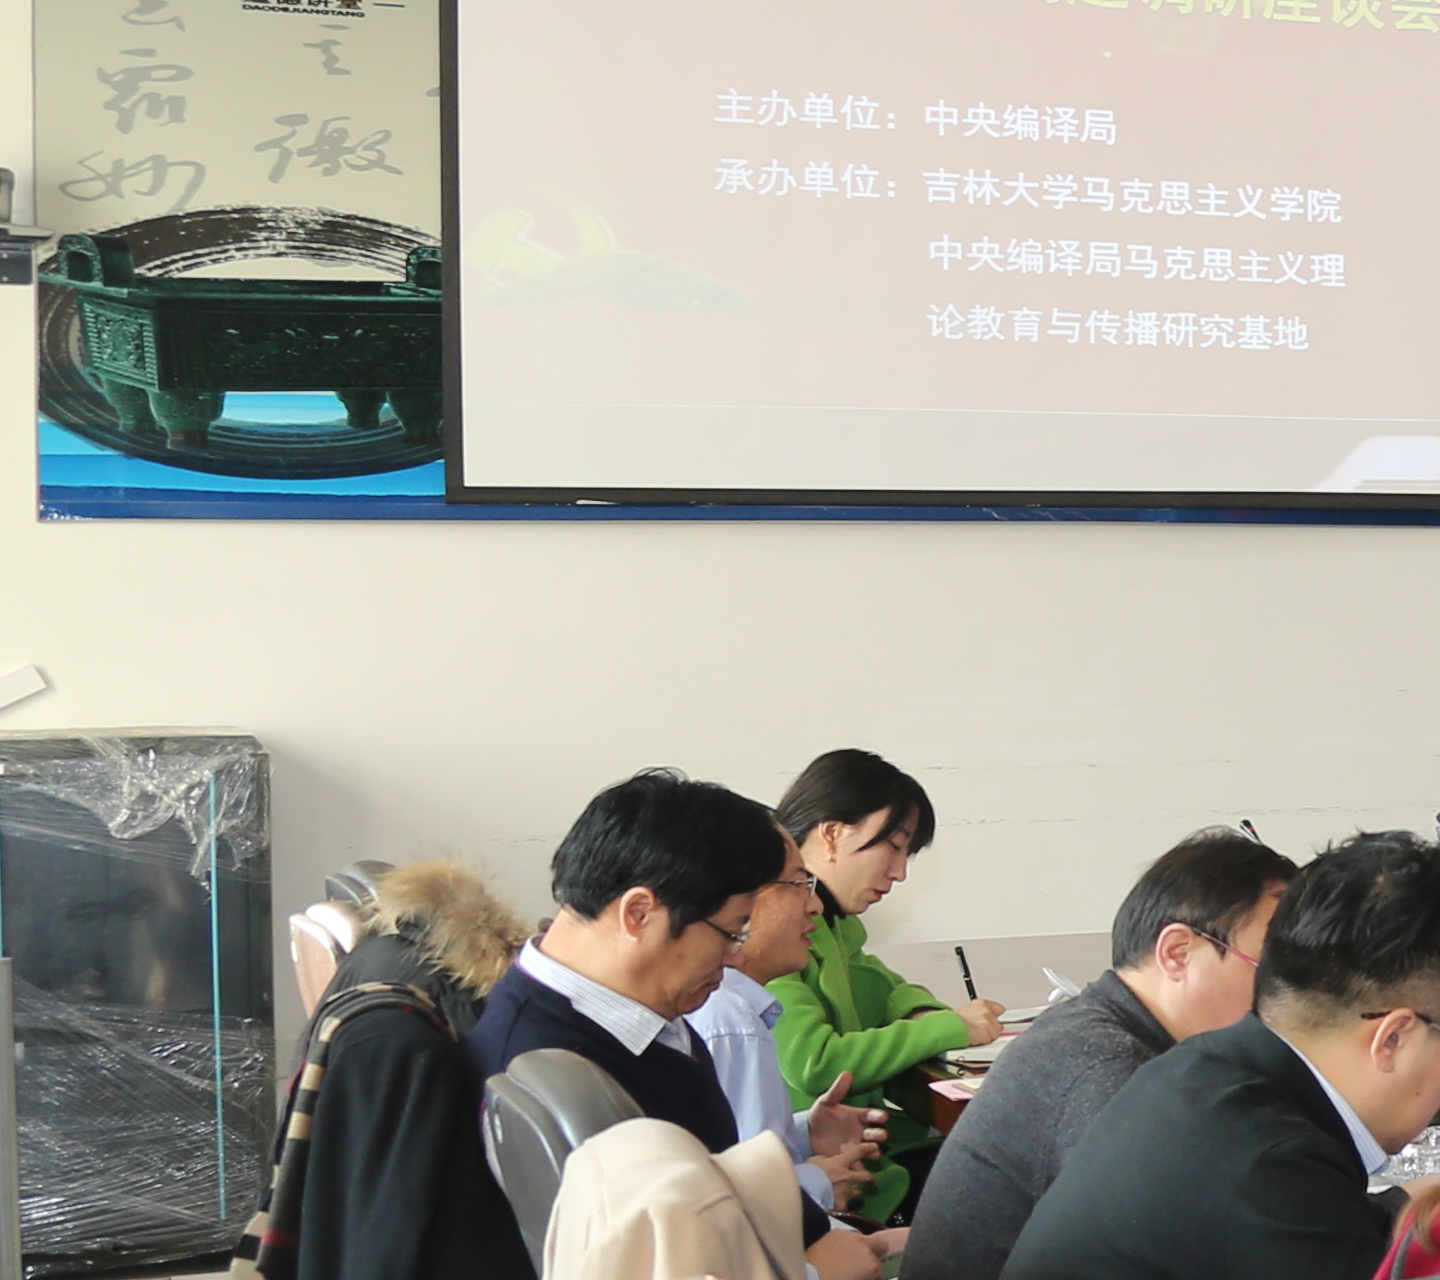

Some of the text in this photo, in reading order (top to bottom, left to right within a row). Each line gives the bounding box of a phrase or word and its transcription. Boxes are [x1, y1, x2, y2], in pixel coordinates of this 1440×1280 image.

[927, 234, 1347, 289] 中央编译局马克思主义理
[927, 303, 1310, 352] 论教育与传播研究基地
